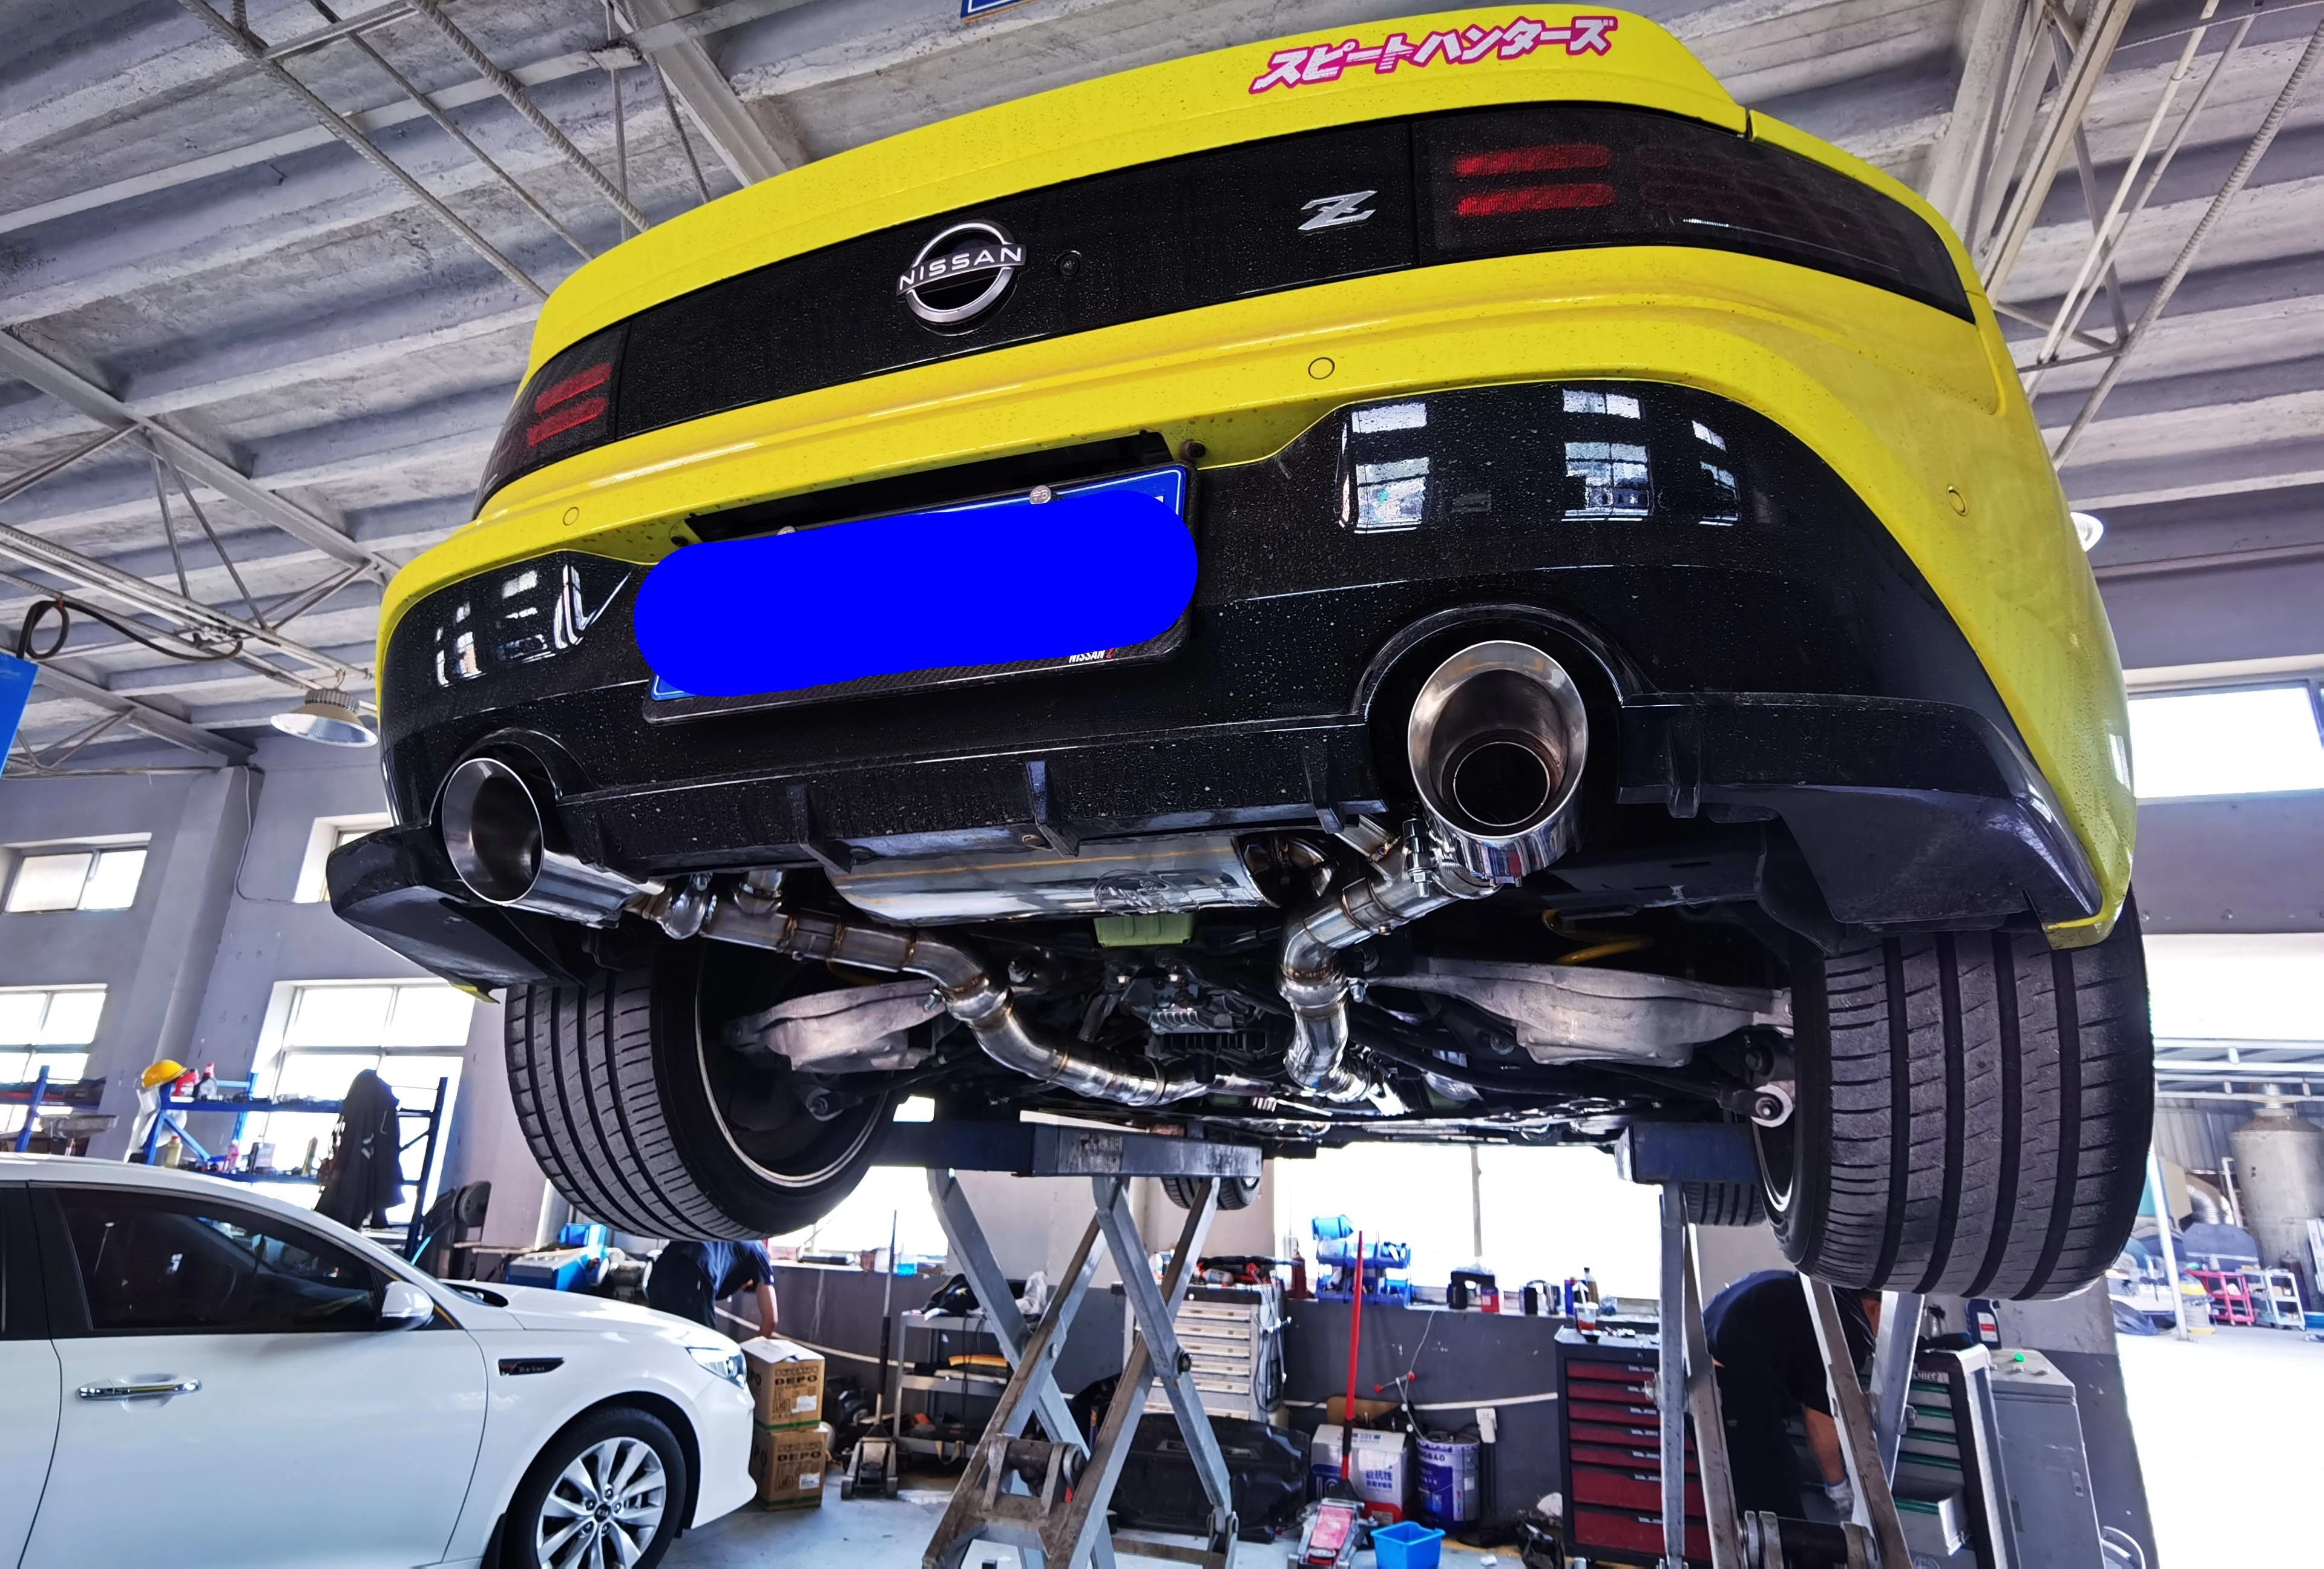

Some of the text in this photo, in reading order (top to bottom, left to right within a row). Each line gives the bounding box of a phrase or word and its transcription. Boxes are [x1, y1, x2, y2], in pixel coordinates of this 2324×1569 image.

[1298, 190, 1377, 231] Z
[899, 247, 1022, 290] NISSAN
[1068, 650, 1106, 663] NISSAN
[775, 1375, 818, 1385] DEPO
[777, 1451, 821, 1462] DEPO
